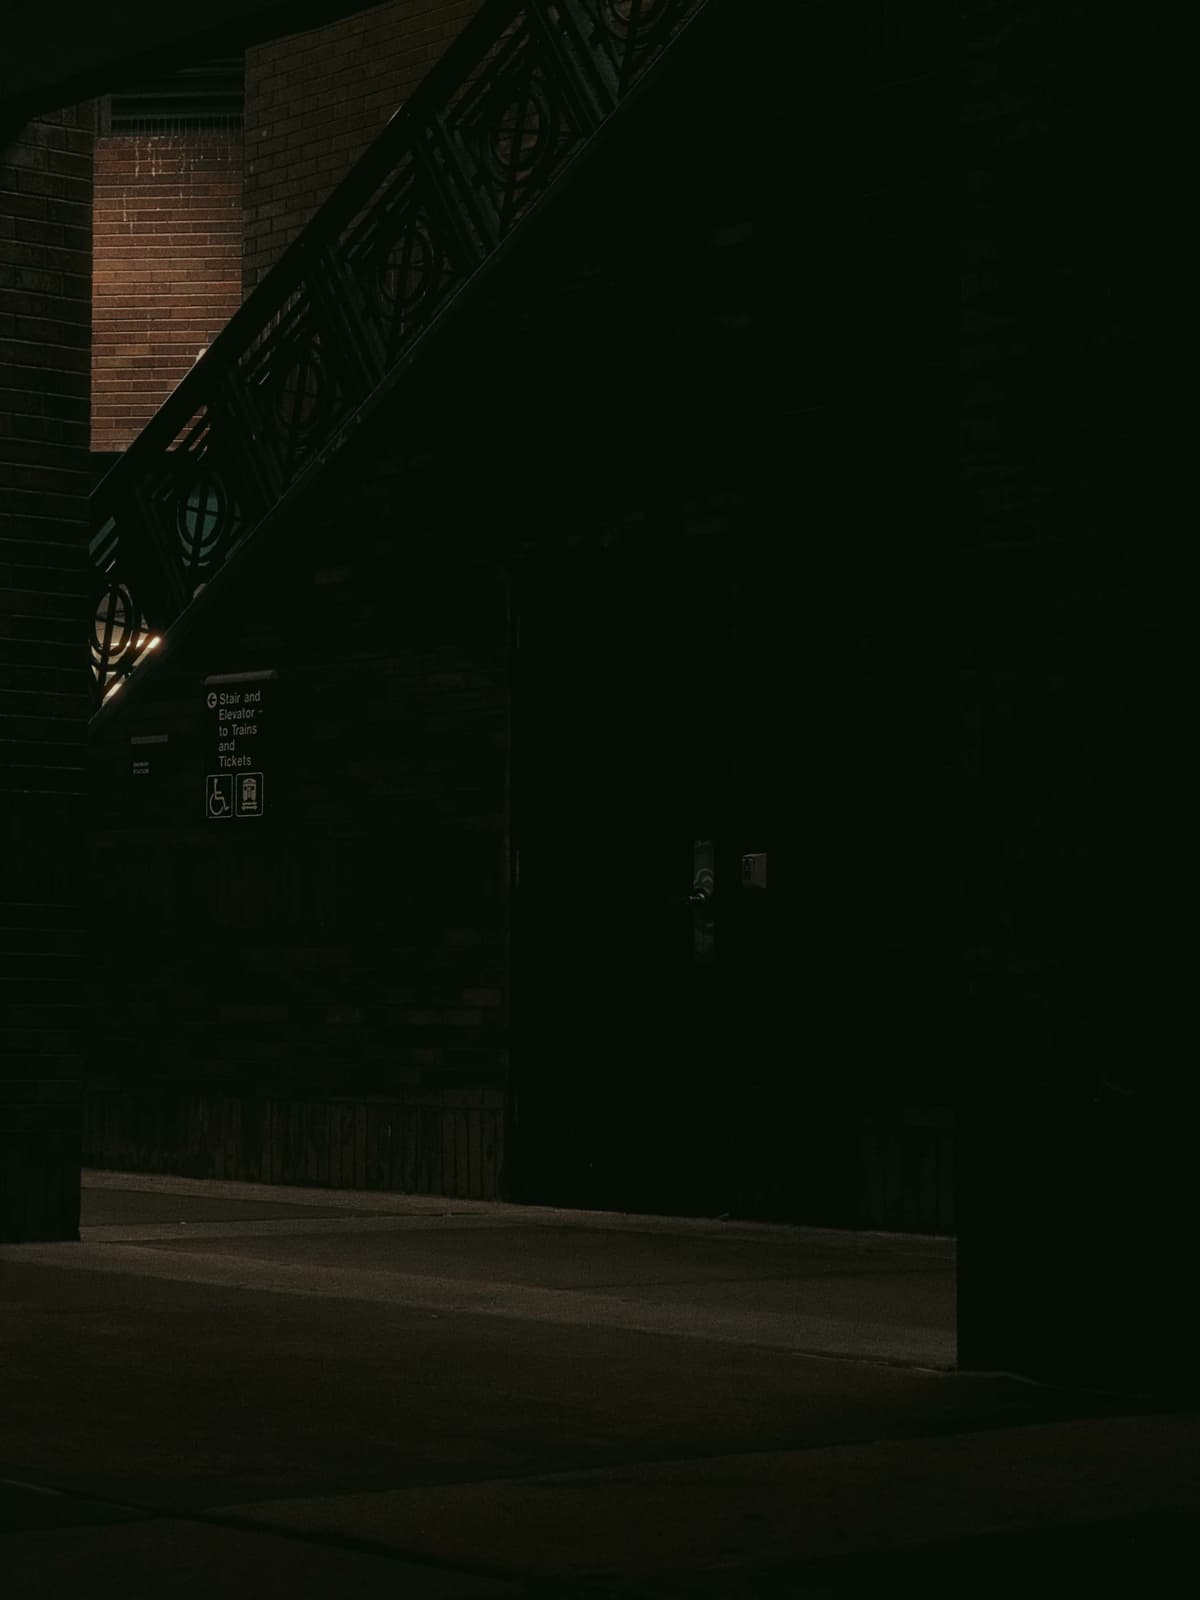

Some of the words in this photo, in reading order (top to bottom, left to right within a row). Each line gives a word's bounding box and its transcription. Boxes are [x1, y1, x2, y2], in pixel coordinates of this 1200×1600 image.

[219, 692, 240, 705] Stair
[244, 690, 261, 703] and
[218, 707, 255, 721] Elevator
[218, 725, 228, 737] to
[232, 723, 257, 736] Trains
[218, 738, 235, 752] and
[218, 754, 252, 768] Tickets
